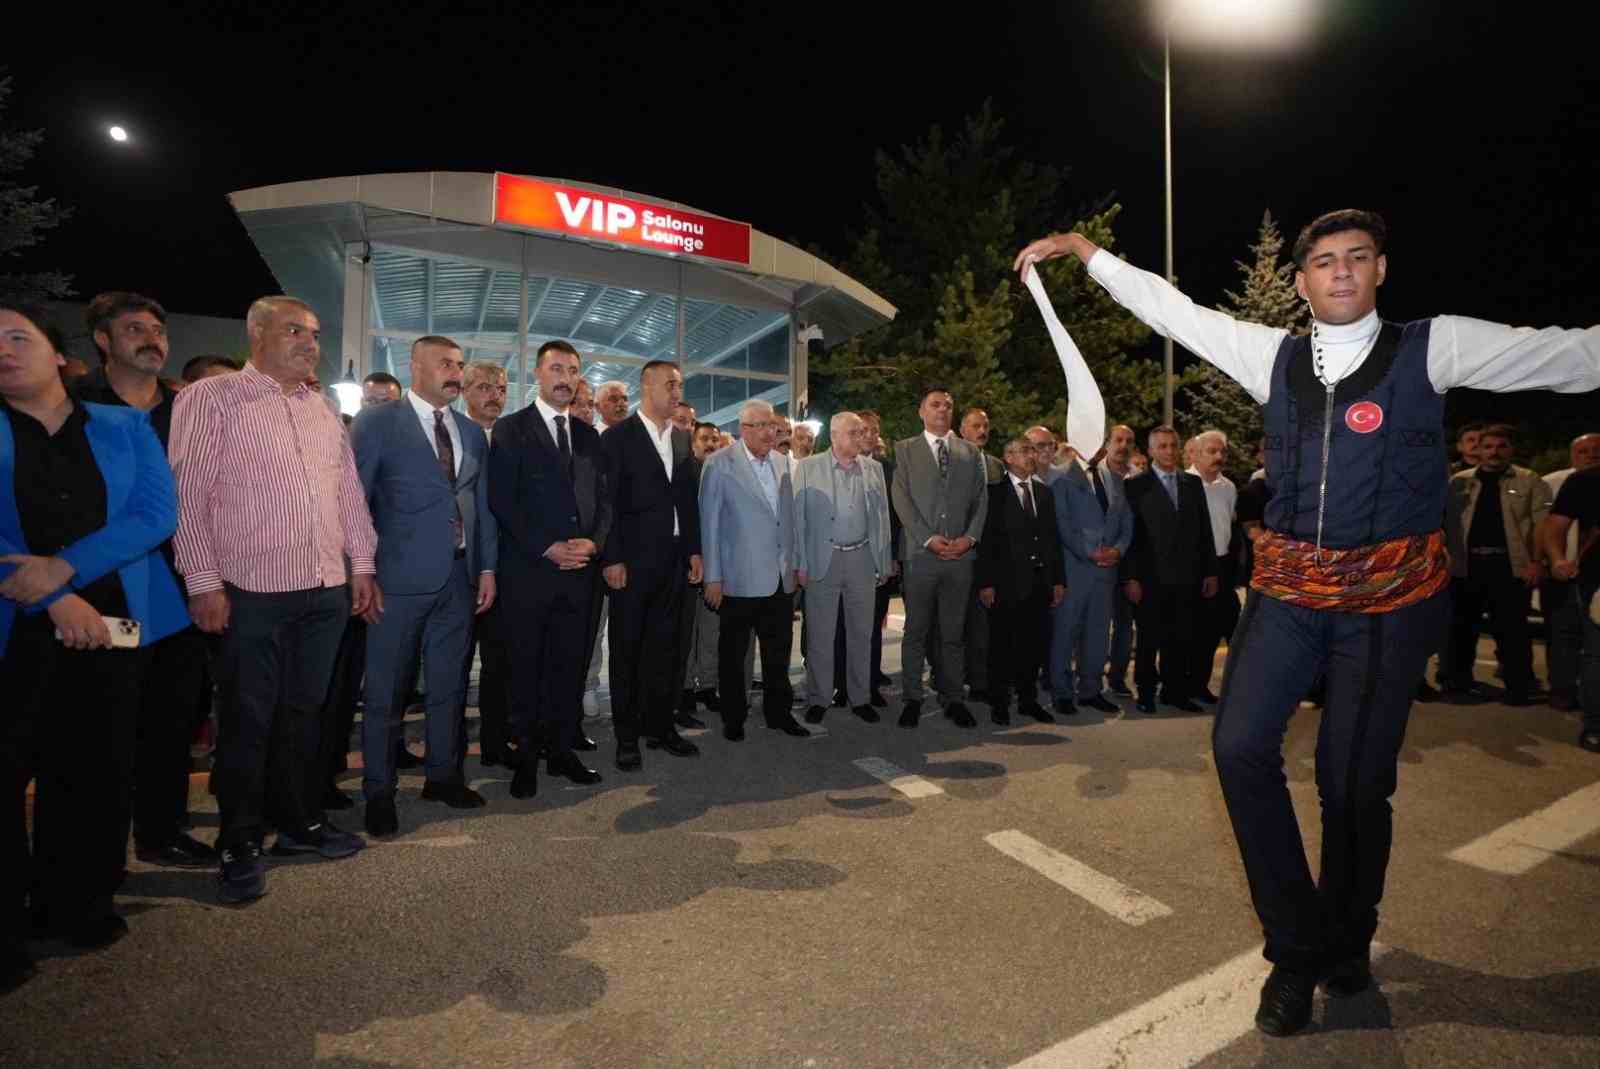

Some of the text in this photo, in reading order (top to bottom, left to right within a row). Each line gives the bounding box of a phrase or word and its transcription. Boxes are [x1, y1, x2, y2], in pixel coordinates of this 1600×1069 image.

[555, 191, 636, 235] VIP
[641, 210, 704, 235] Salonu
[641, 226, 704, 252] Lounge
